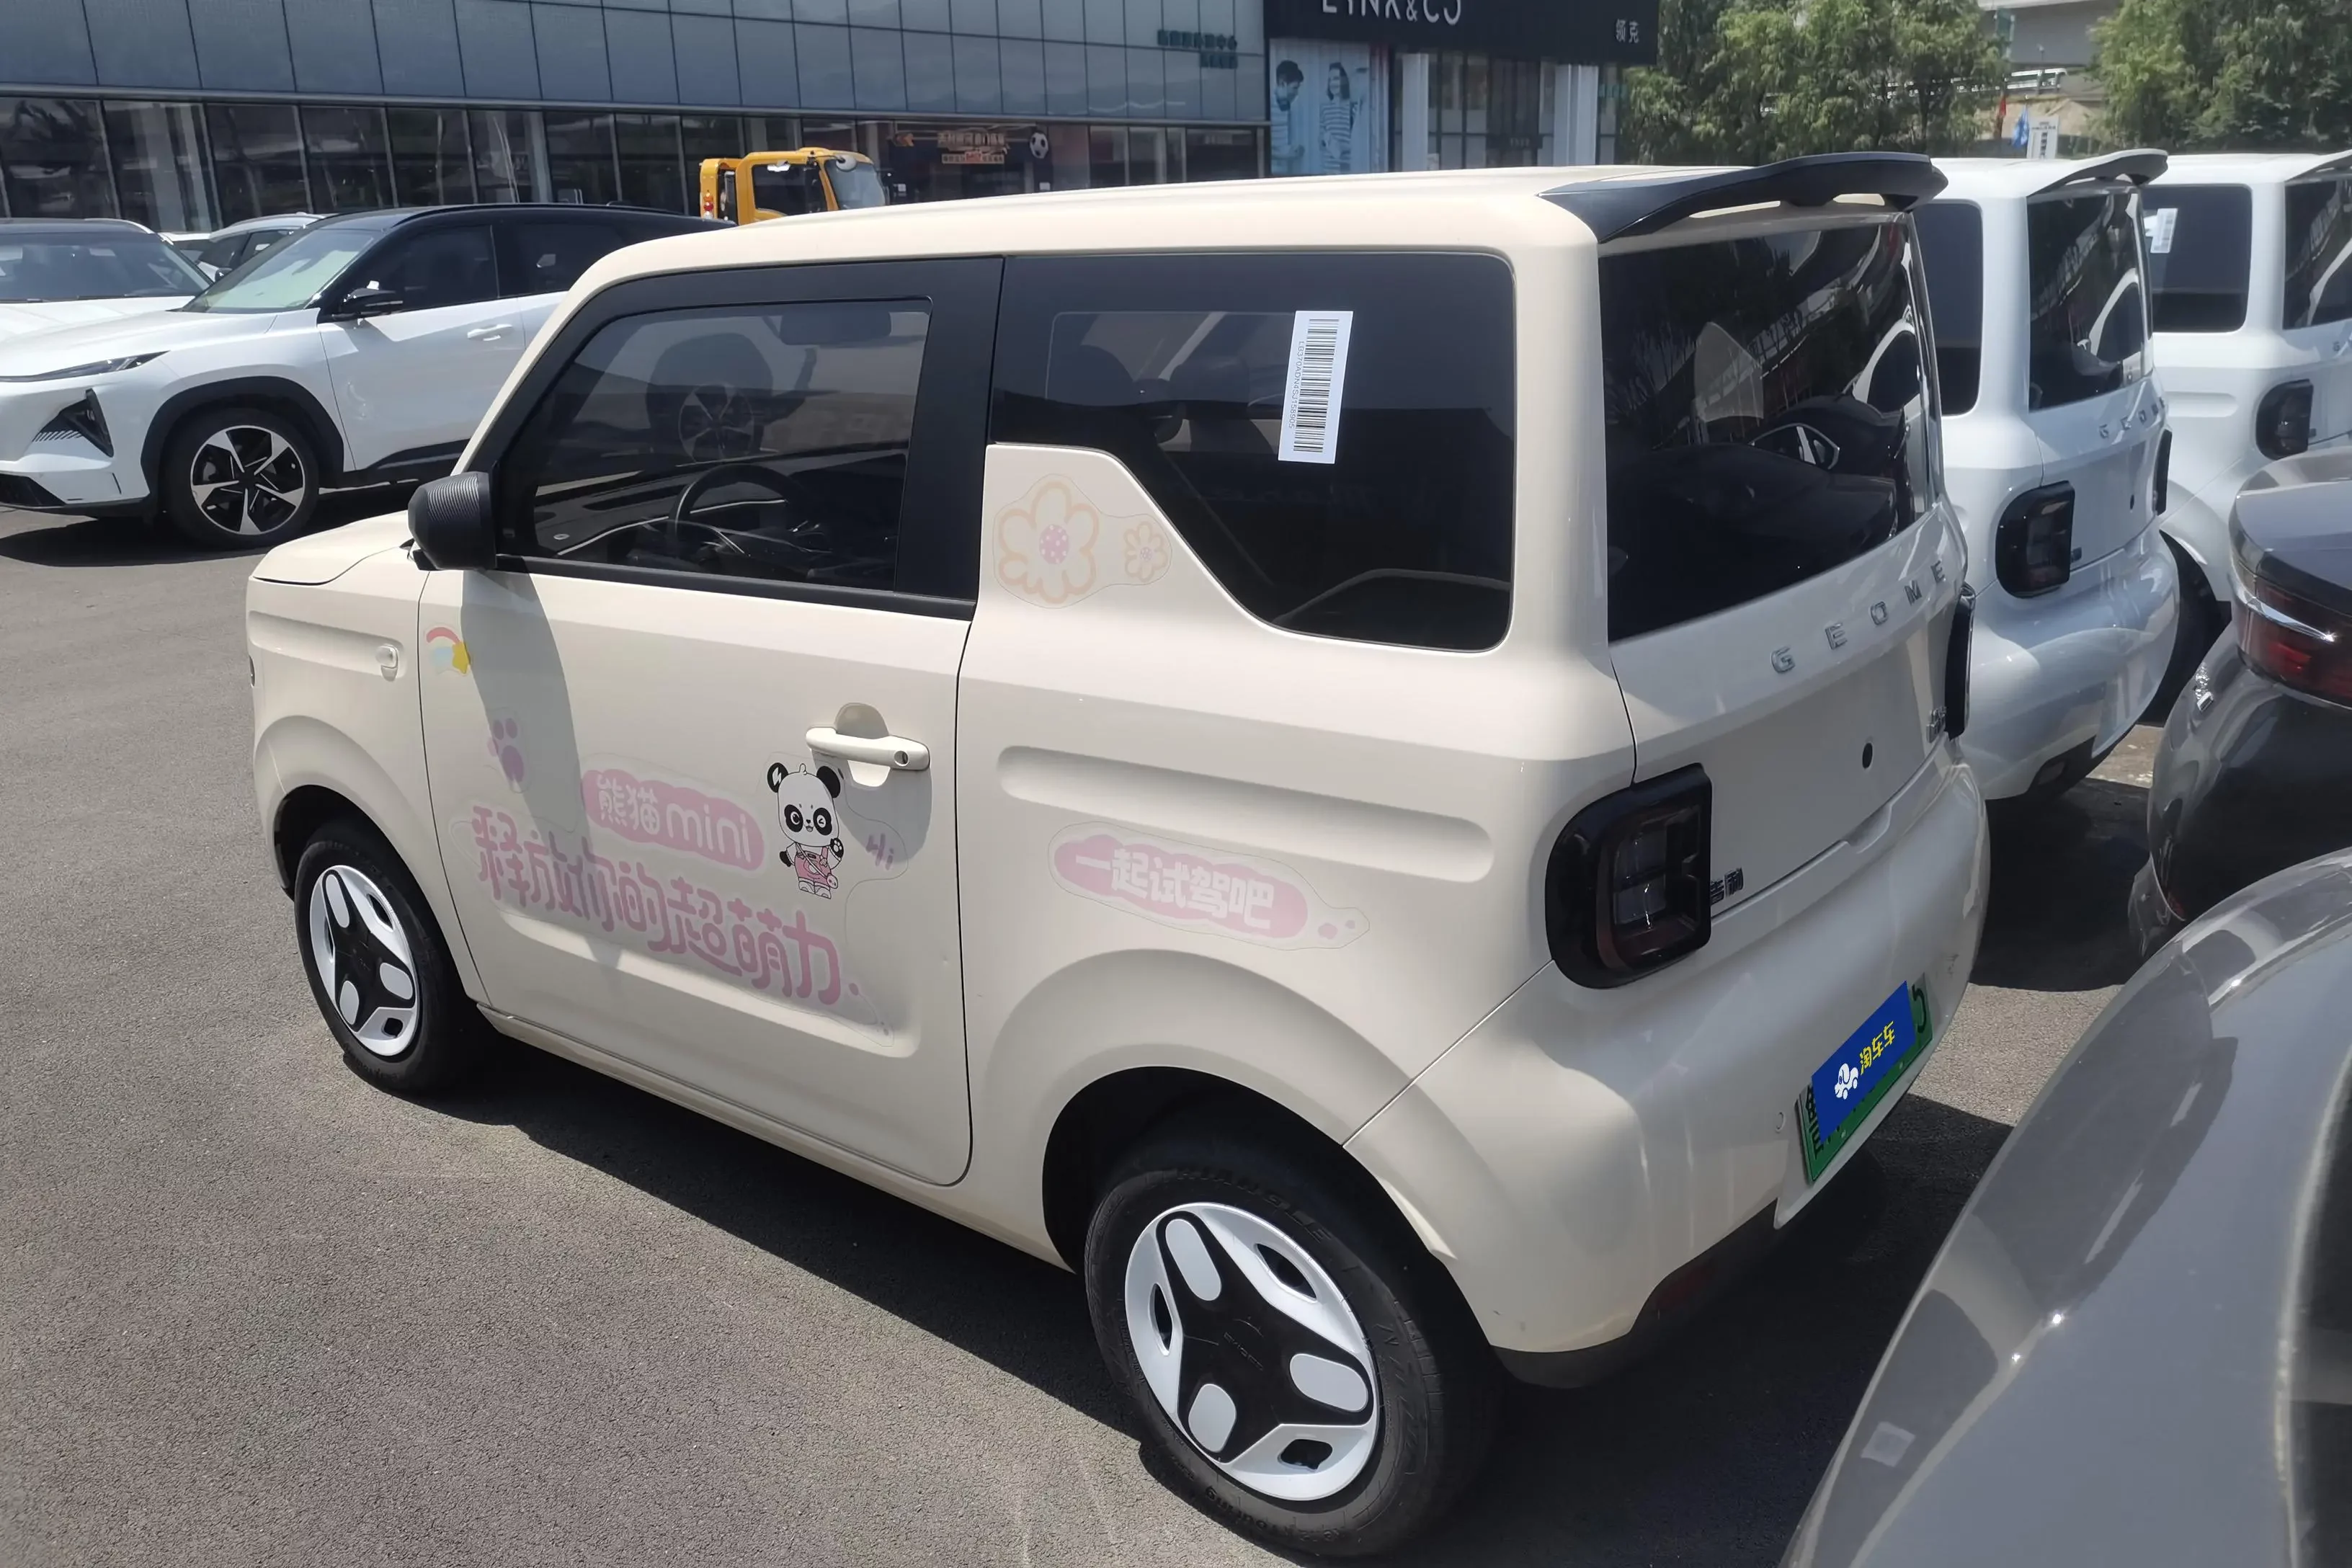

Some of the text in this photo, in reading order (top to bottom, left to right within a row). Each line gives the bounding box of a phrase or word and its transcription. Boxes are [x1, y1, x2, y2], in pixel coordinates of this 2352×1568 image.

[1770, 560, 1945, 674] GEOME
[471, 806, 841, 1005] 释放你的超萌力
[1076, 847, 1274, 930] 一起试驾吧
